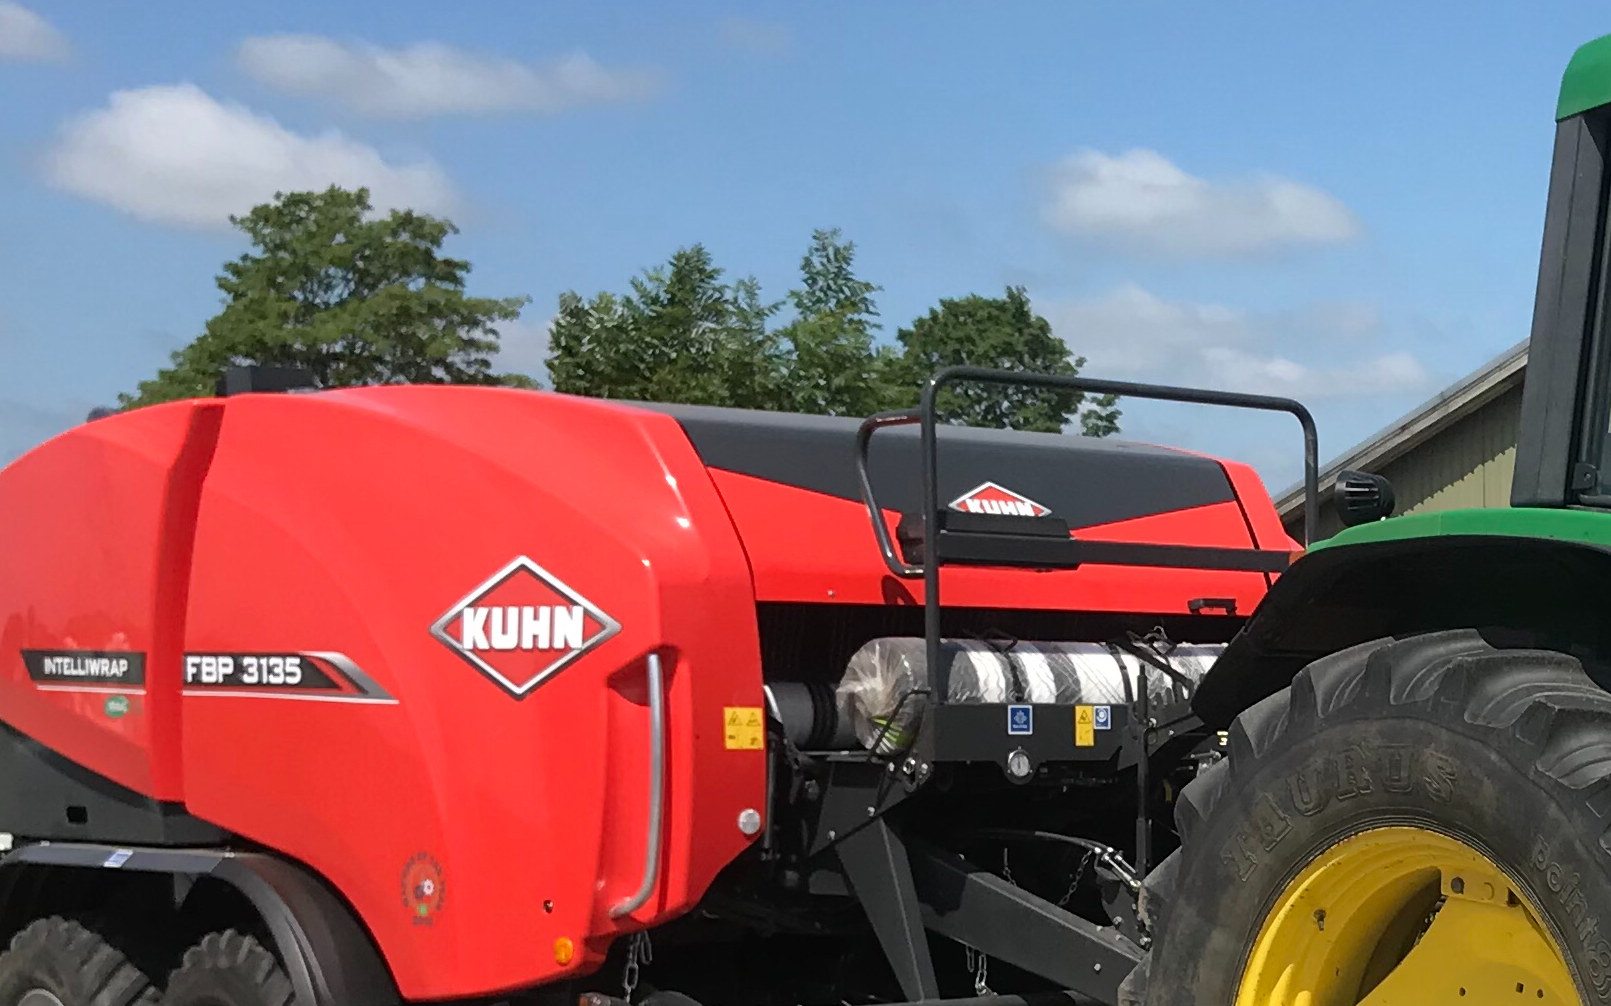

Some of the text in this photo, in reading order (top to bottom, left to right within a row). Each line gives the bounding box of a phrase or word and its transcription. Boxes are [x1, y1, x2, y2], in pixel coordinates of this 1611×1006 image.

[965, 499, 1035, 516] KUHN
[462, 605, 584, 650] KUHN
[44, 656, 128, 677] INTELLIWRAP
[186, 656, 302, 684] FBP 3135
[1219, 742, 1458, 882] TAURUS
